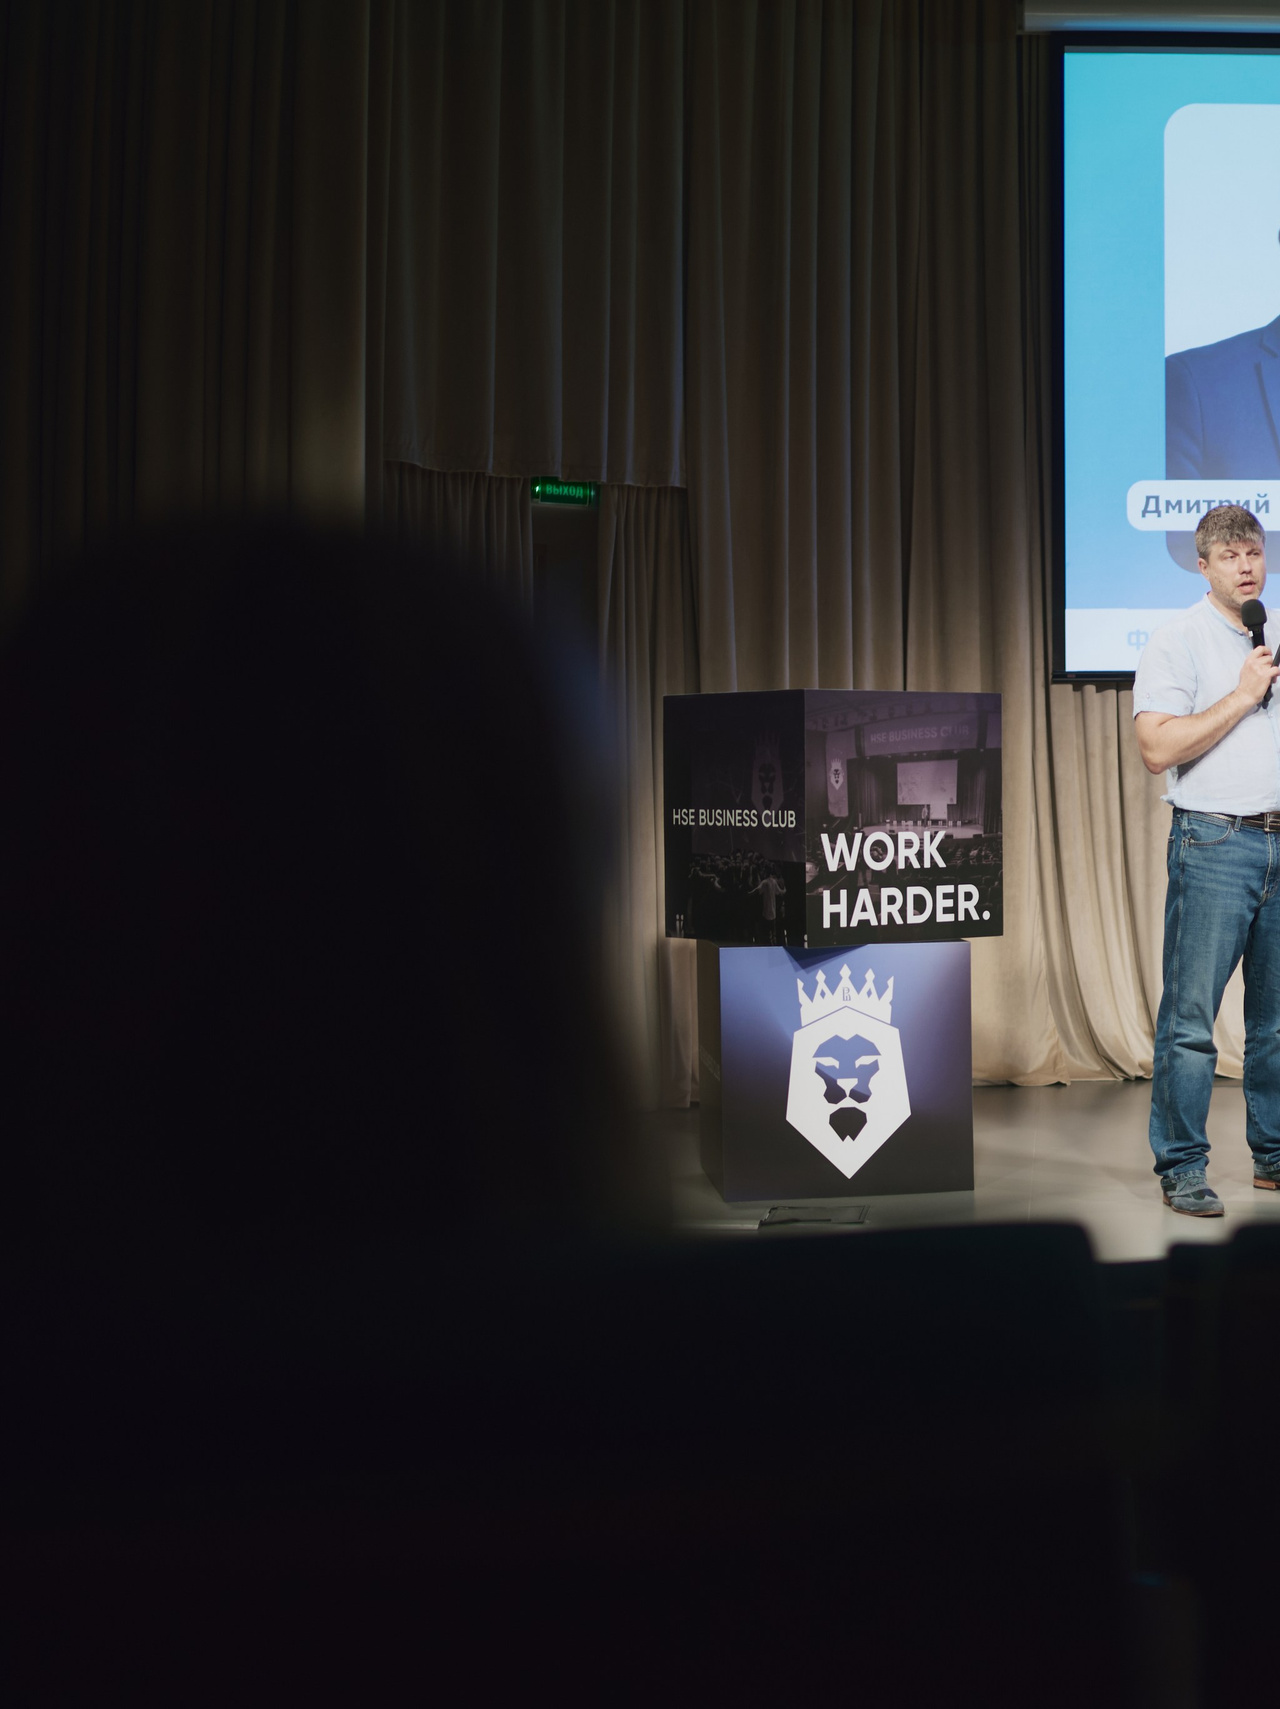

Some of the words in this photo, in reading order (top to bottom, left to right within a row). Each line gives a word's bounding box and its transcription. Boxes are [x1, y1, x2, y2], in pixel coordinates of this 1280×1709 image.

[546, 484, 584, 498] ВЫХОД
[1141, 493, 1270, 518] Дмитий
[889, 727, 938, 742] BUSINESS
[673, 808, 696, 825] HSE
[699, 809, 758, 827] BUSINESS
[762, 810, 796, 828] CLUB
[820, 831, 947, 872] WORK
[822, 884, 991, 928] HARDER.
